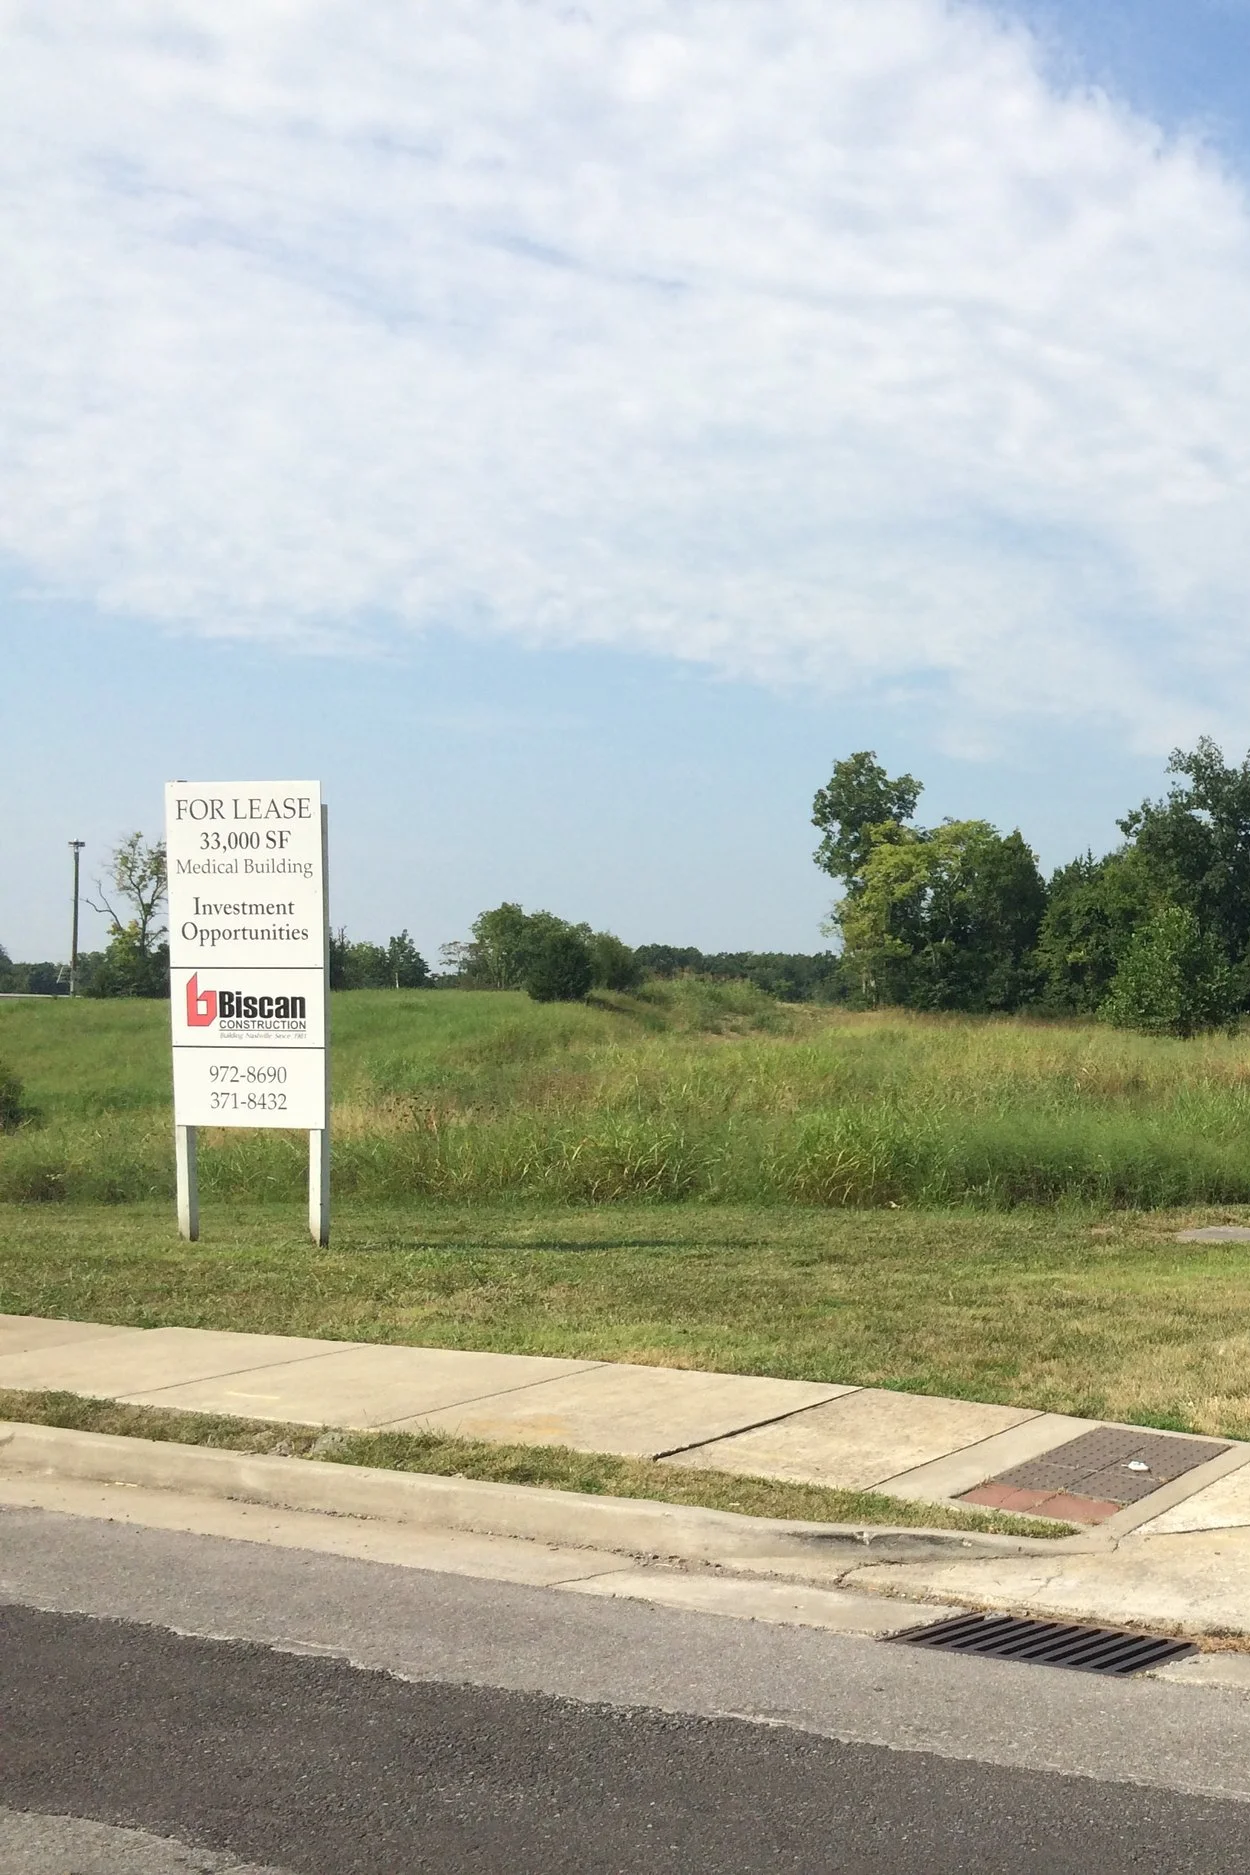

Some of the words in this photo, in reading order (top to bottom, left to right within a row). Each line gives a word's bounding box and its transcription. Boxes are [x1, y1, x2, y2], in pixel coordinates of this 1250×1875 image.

[176, 799, 225, 820] FOR
[232, 798, 311, 819] LEASE
[200, 832, 260, 852] 33,000
[266, 831, 291, 849] SF
[176, 859, 238, 874] Medical
[244, 859, 313, 878] Building
[193, 897, 294, 915] Investment
[182, 922, 308, 946] Opportunities
[219, 991, 306, 1018] Biscan
[219, 1020, 306, 1029] CONSTRUCTION
[209, 1066, 287, 1083] 972-8690
[211, 1092, 287, 1110] 371-8432
